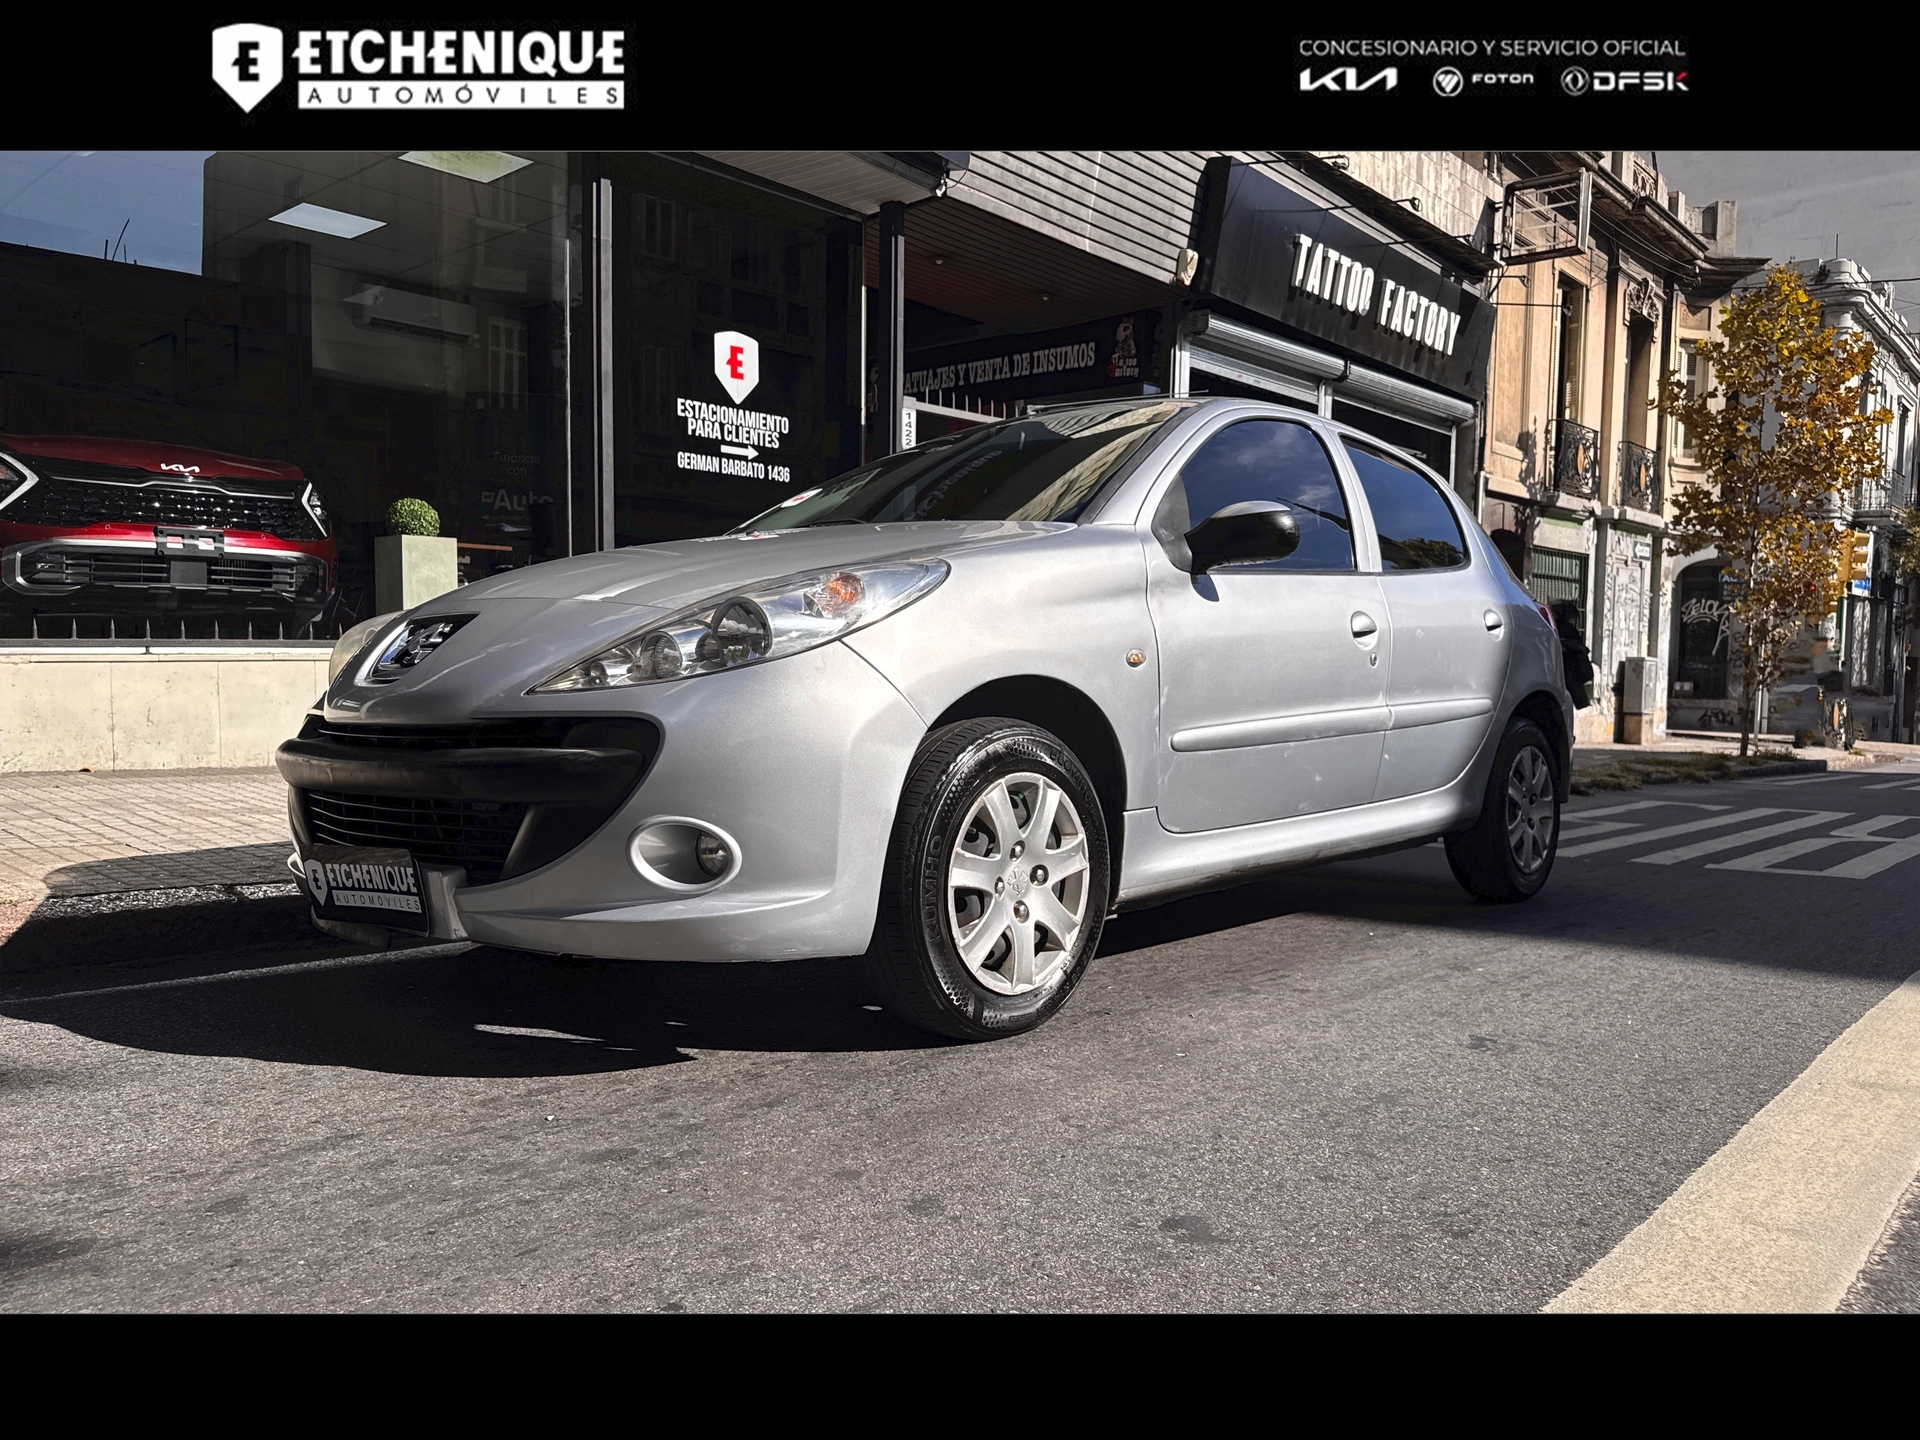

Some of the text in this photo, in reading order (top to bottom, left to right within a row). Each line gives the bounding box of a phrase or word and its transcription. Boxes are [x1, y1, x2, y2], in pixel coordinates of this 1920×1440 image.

[1292, 233, 1461, 356] TATTOO FACTORY
[903, 341, 1096, 394] ATUAJES Y VENTA DE INSUMOS
[677, 397, 789, 434] ESTACIONAMIENTO
[687, 418, 780, 449] PARA CLIENTES
[904, 412, 913, 447] 1422
[677, 451, 790, 483] GERMAN BARBATO 1436
[325, 863, 418, 893] ETCHENIQUE
[924, 835, 942, 943] KUMHO
